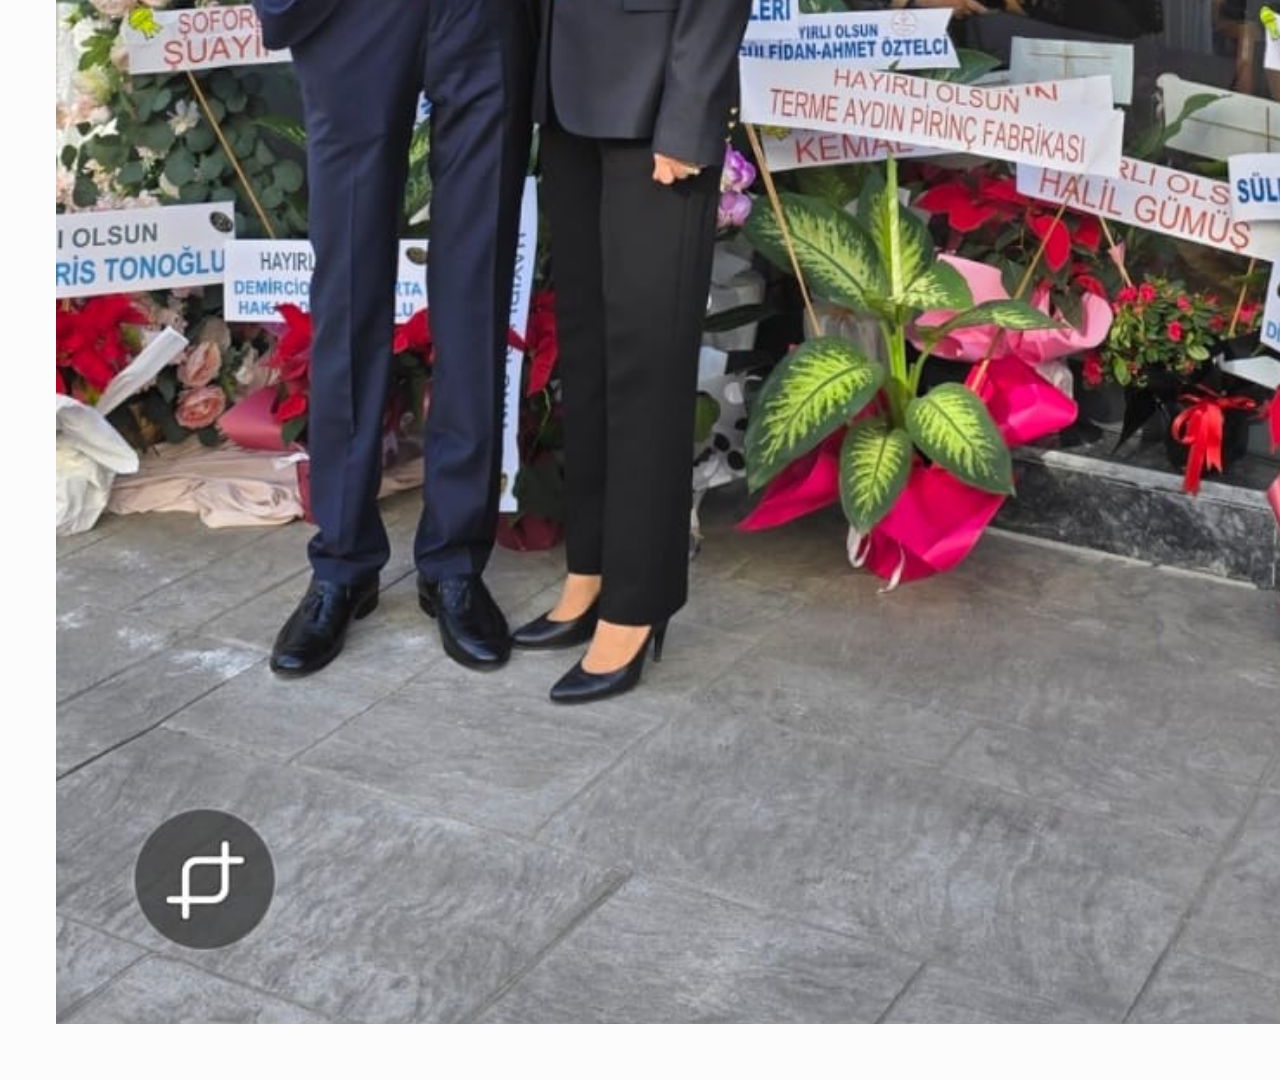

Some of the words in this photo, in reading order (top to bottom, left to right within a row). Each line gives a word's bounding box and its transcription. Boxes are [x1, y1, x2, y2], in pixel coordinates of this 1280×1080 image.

[835, 23, 878, 39] OLSUN
[881, 34, 948, 57] ÖZTELCİ
[834, 68, 928, 98] HAYIRLI
[936, 82, 1019, 114] OLSUN
[770, 88, 839, 122] TERME
[844, 98, 904, 134] AYDIN
[910, 104, 977, 150] PİRİNÇ
[983, 119, 1085, 164] FABRİKASI
[1040, 167, 1121, 216] HALİL
[1134, 194, 1251, 254] GÜMÜŞ
[72, 223, 157, 248] OLSUN
[104, 247, 225, 283] TONOĞLU
